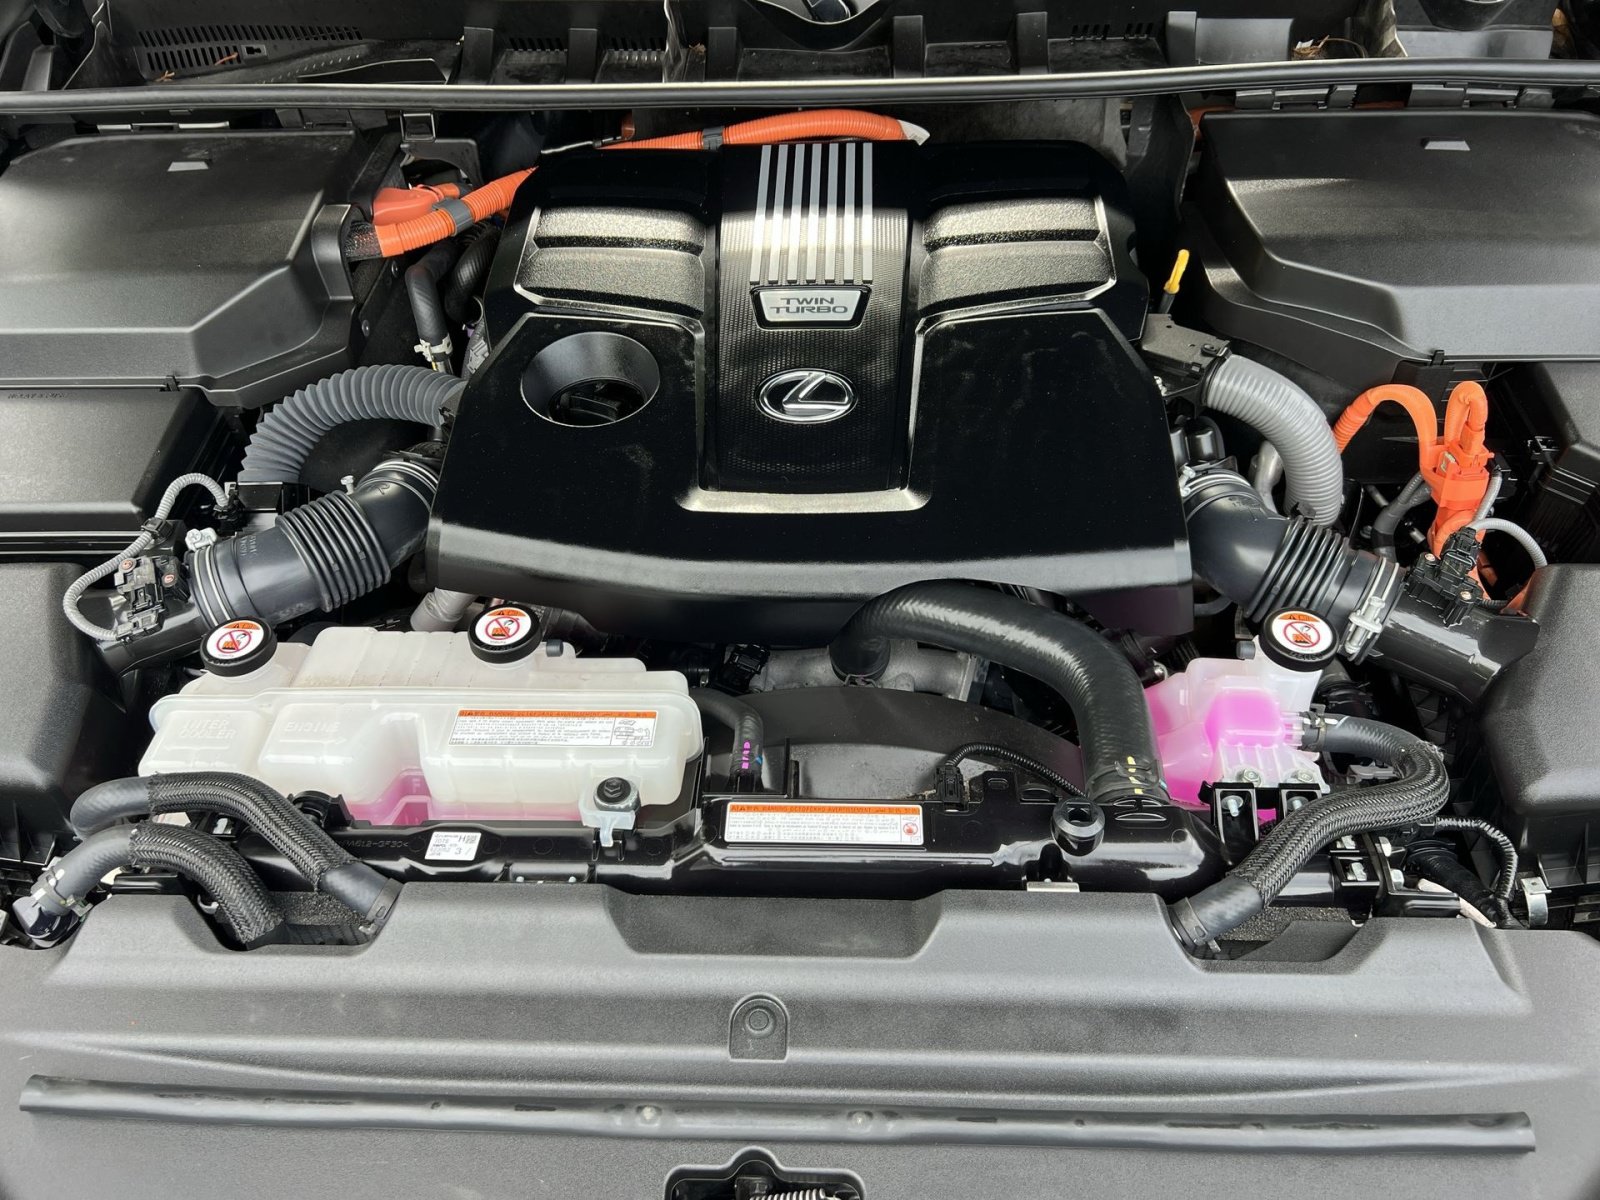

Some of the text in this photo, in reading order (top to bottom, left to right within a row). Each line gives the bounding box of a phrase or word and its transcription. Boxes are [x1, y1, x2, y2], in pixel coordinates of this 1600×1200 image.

[780, 297, 835, 305] TWIN
[769, 306, 848, 314] TURBO
[284, 721, 341, 733] ENGINE
